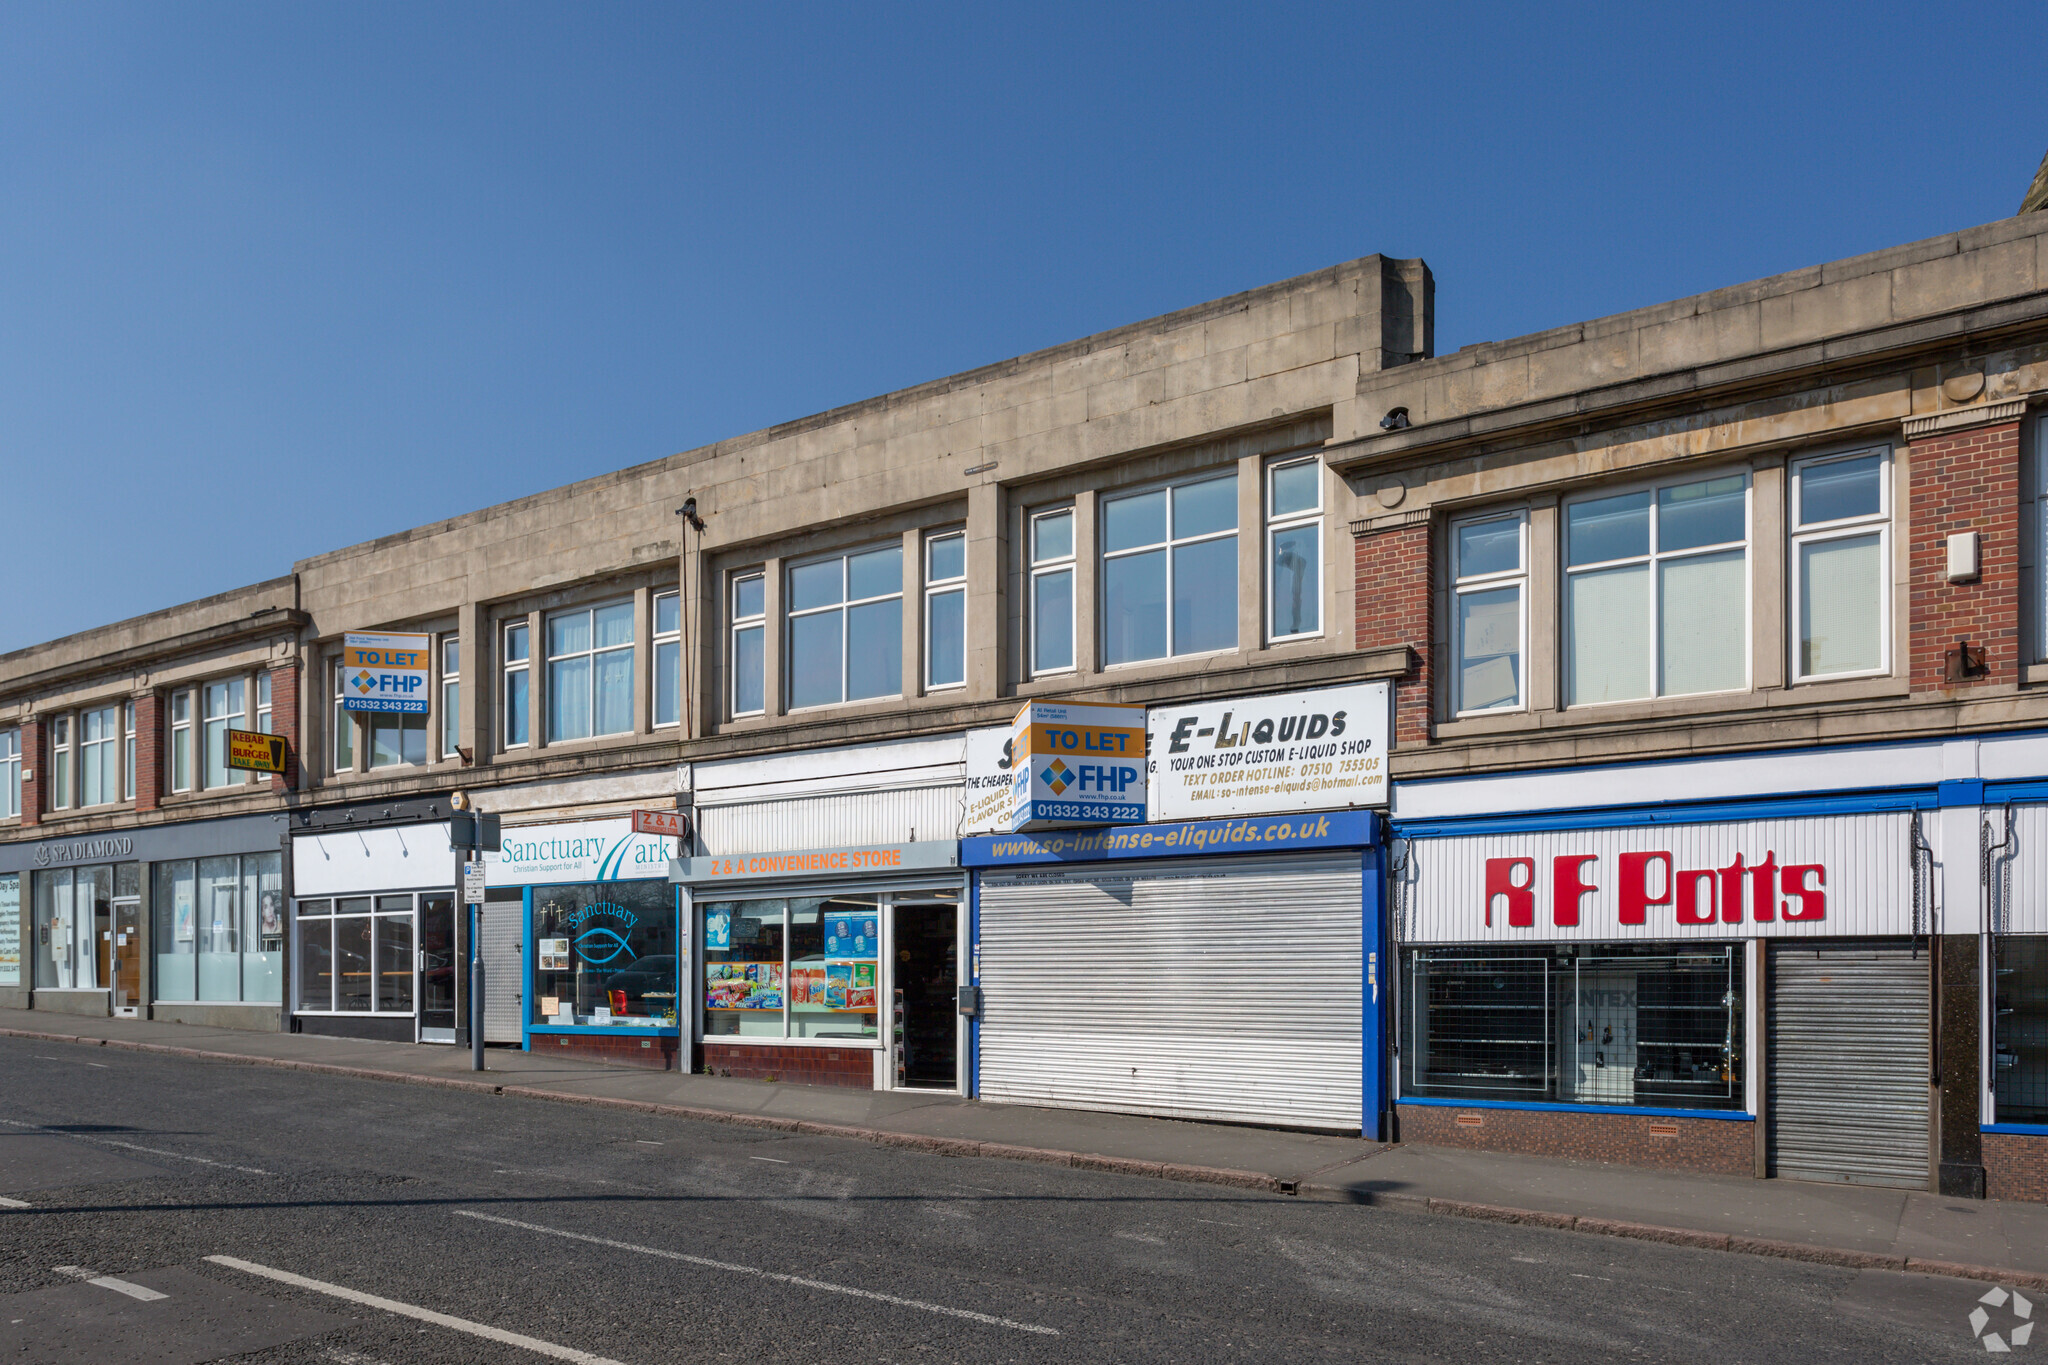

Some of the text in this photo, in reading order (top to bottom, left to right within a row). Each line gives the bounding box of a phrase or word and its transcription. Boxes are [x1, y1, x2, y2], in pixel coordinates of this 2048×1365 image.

[355, 651, 418, 666] TO LET
[380, 674, 422, 692] FHP
[349, 700, 423, 711] 01332 343 222
[232, 732, 264, 744] KEBAB
[1046, 730, 1079, 750] TO
[1085, 732, 1130, 752] LET
[232, 747, 270, 760] BURGER
[233, 757, 250, 766] TAKE
[1170, 757, 1194, 772] YOUR
[1196, 755, 1216, 769] ONE
[1218, 752, 1242, 767] STOP
[1245, 748, 1285, 764] CUSTOM
[1288, 743, 1336, 760] E-LIQUID
[1340, 739, 1372, 755] SHOP
[967, 777, 981, 789] THE
[1017, 766, 1030, 796] FHP
[1079, 765, 1137, 792] FHP
[1183, 757, 1380, 786] TEXT ORDER HOTLINE: 07510 755505
[970, 786, 1010, 813] E-LIQUIDS
[1079, 793, 1126, 801] www.fhp.co.uk
[643, 814, 677, 828] Z & A
[967, 801, 1006, 827] FLAVOUR
[1038, 804, 1139, 819] 01332 343 222
[992, 816, 1330, 857] www.so-intense-eliquids.co.uk
[52, 837, 133, 862] SPA DIAMOND
[502, 837, 606, 864] Sanctuary
[513, 865, 538, 873] Christian
[539, 864, 562, 872] Support
[574, 861, 582, 869] All
[711, 849, 901, 875] Z & A CONVENIENCE STORE
[1485, 850, 1825, 928] R F Potts
[569, 901, 638, 929] Sanctuary
